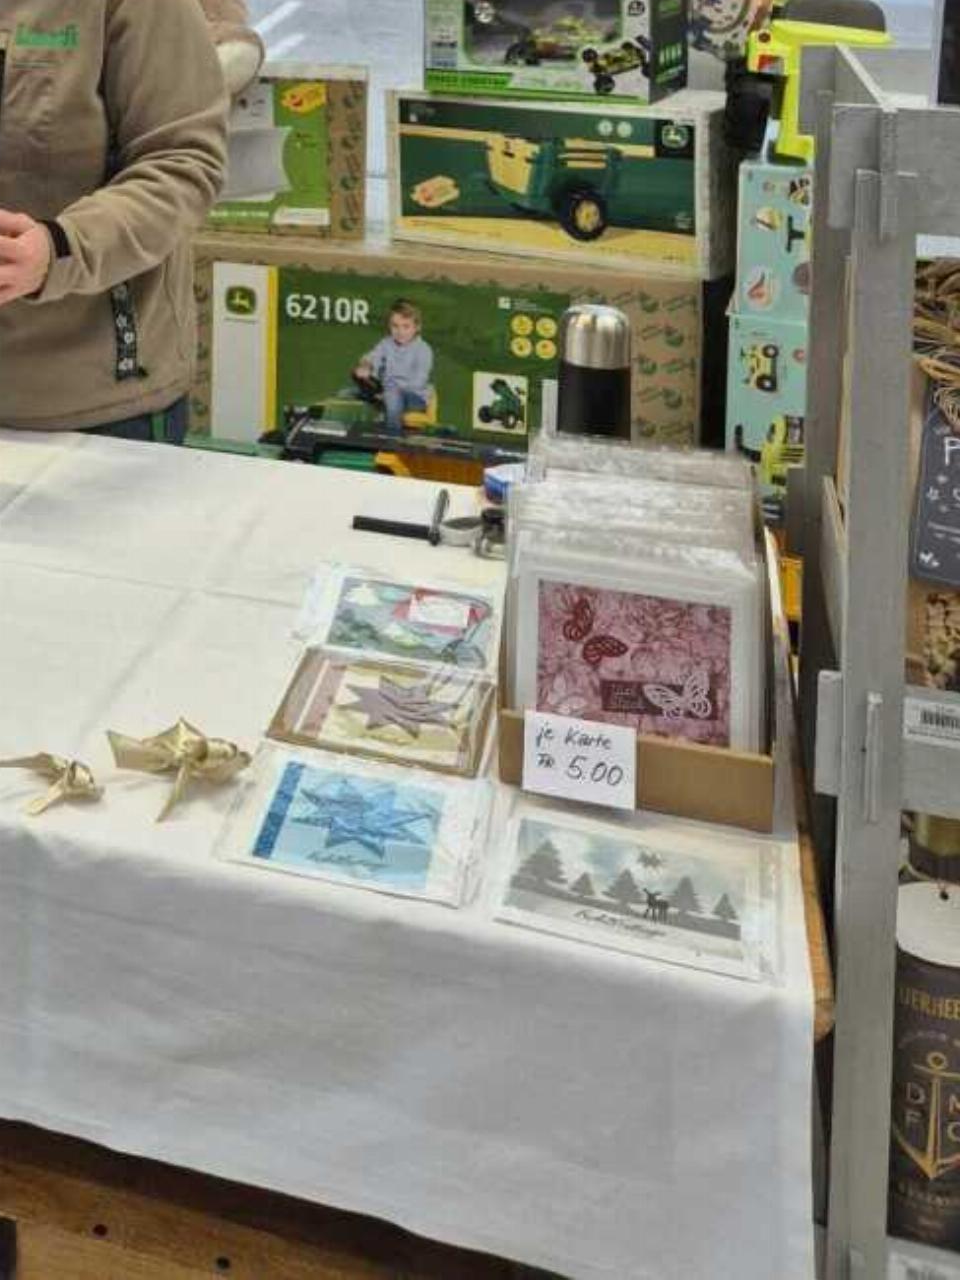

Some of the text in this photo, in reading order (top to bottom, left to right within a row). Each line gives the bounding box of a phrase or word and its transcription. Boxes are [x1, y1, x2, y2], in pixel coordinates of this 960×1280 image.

[285, 293, 370, 325] 6210R
[565, 726, 611, 750] Karte
[567, 755, 623, 786] 5.00
